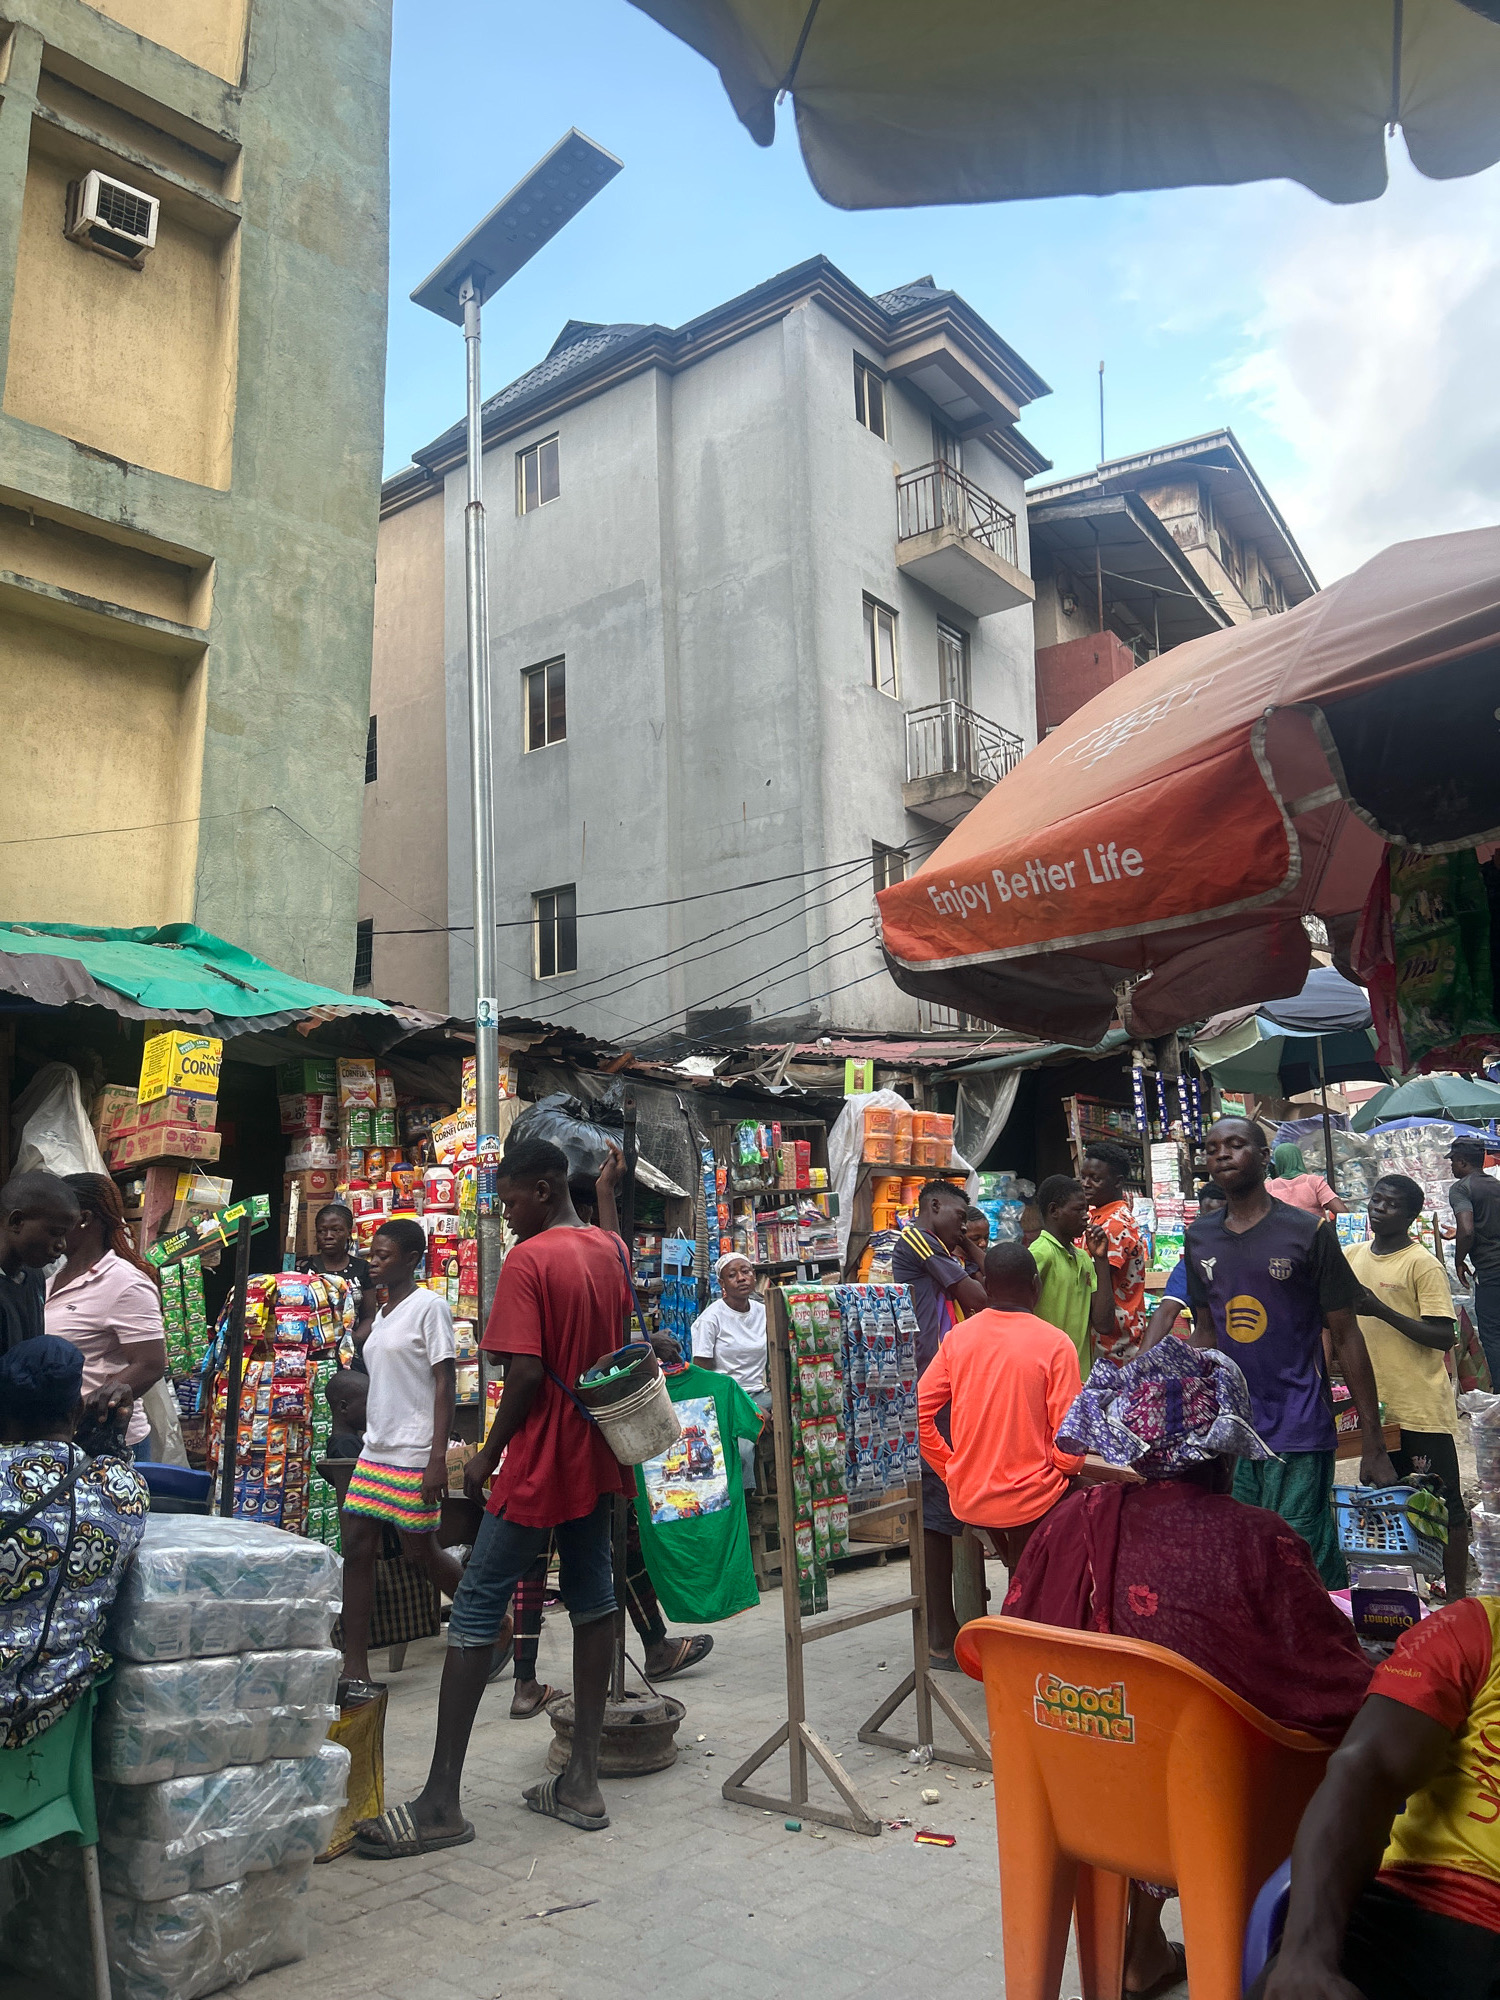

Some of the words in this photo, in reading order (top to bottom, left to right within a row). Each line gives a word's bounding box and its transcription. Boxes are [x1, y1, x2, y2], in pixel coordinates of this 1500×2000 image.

[927, 880, 991, 918] Enjoy
[992, 858, 1075, 902] Better
[1084, 841, 1144, 884] Life
[1401, 956, 1440, 985] Viva
[312, 1176, 325, 1184] 20g
[1159, 1248, 1179, 1257] Viva
[878, 1300, 889, 1310] JIK
[899, 1298, 910, 1308] JIK
[794, 1307, 811, 1321] hypo
[813, 1305, 829, 1319] hypo
[883, 1351, 896, 1362] JIK
[901, 1345, 913, 1356] JIK
[903, 1395, 915, 1406] JIK
[887, 1403, 899, 1414] JIK
[819, 1429, 837, 1445] hypo
[860, 1451, 872, 1463] JIK
[906, 1447, 917, 1458] JIK
[891, 1456, 902, 1467] JIK
[831, 1510, 848, 1524] hypo
[1363, 1614, 1414, 1628] Diplomat
[1383, 1664, 1422, 1678] Neoskin
[1036, 1674, 1123, 1715] Good
[1037, 1702, 1131, 1738] Mama
